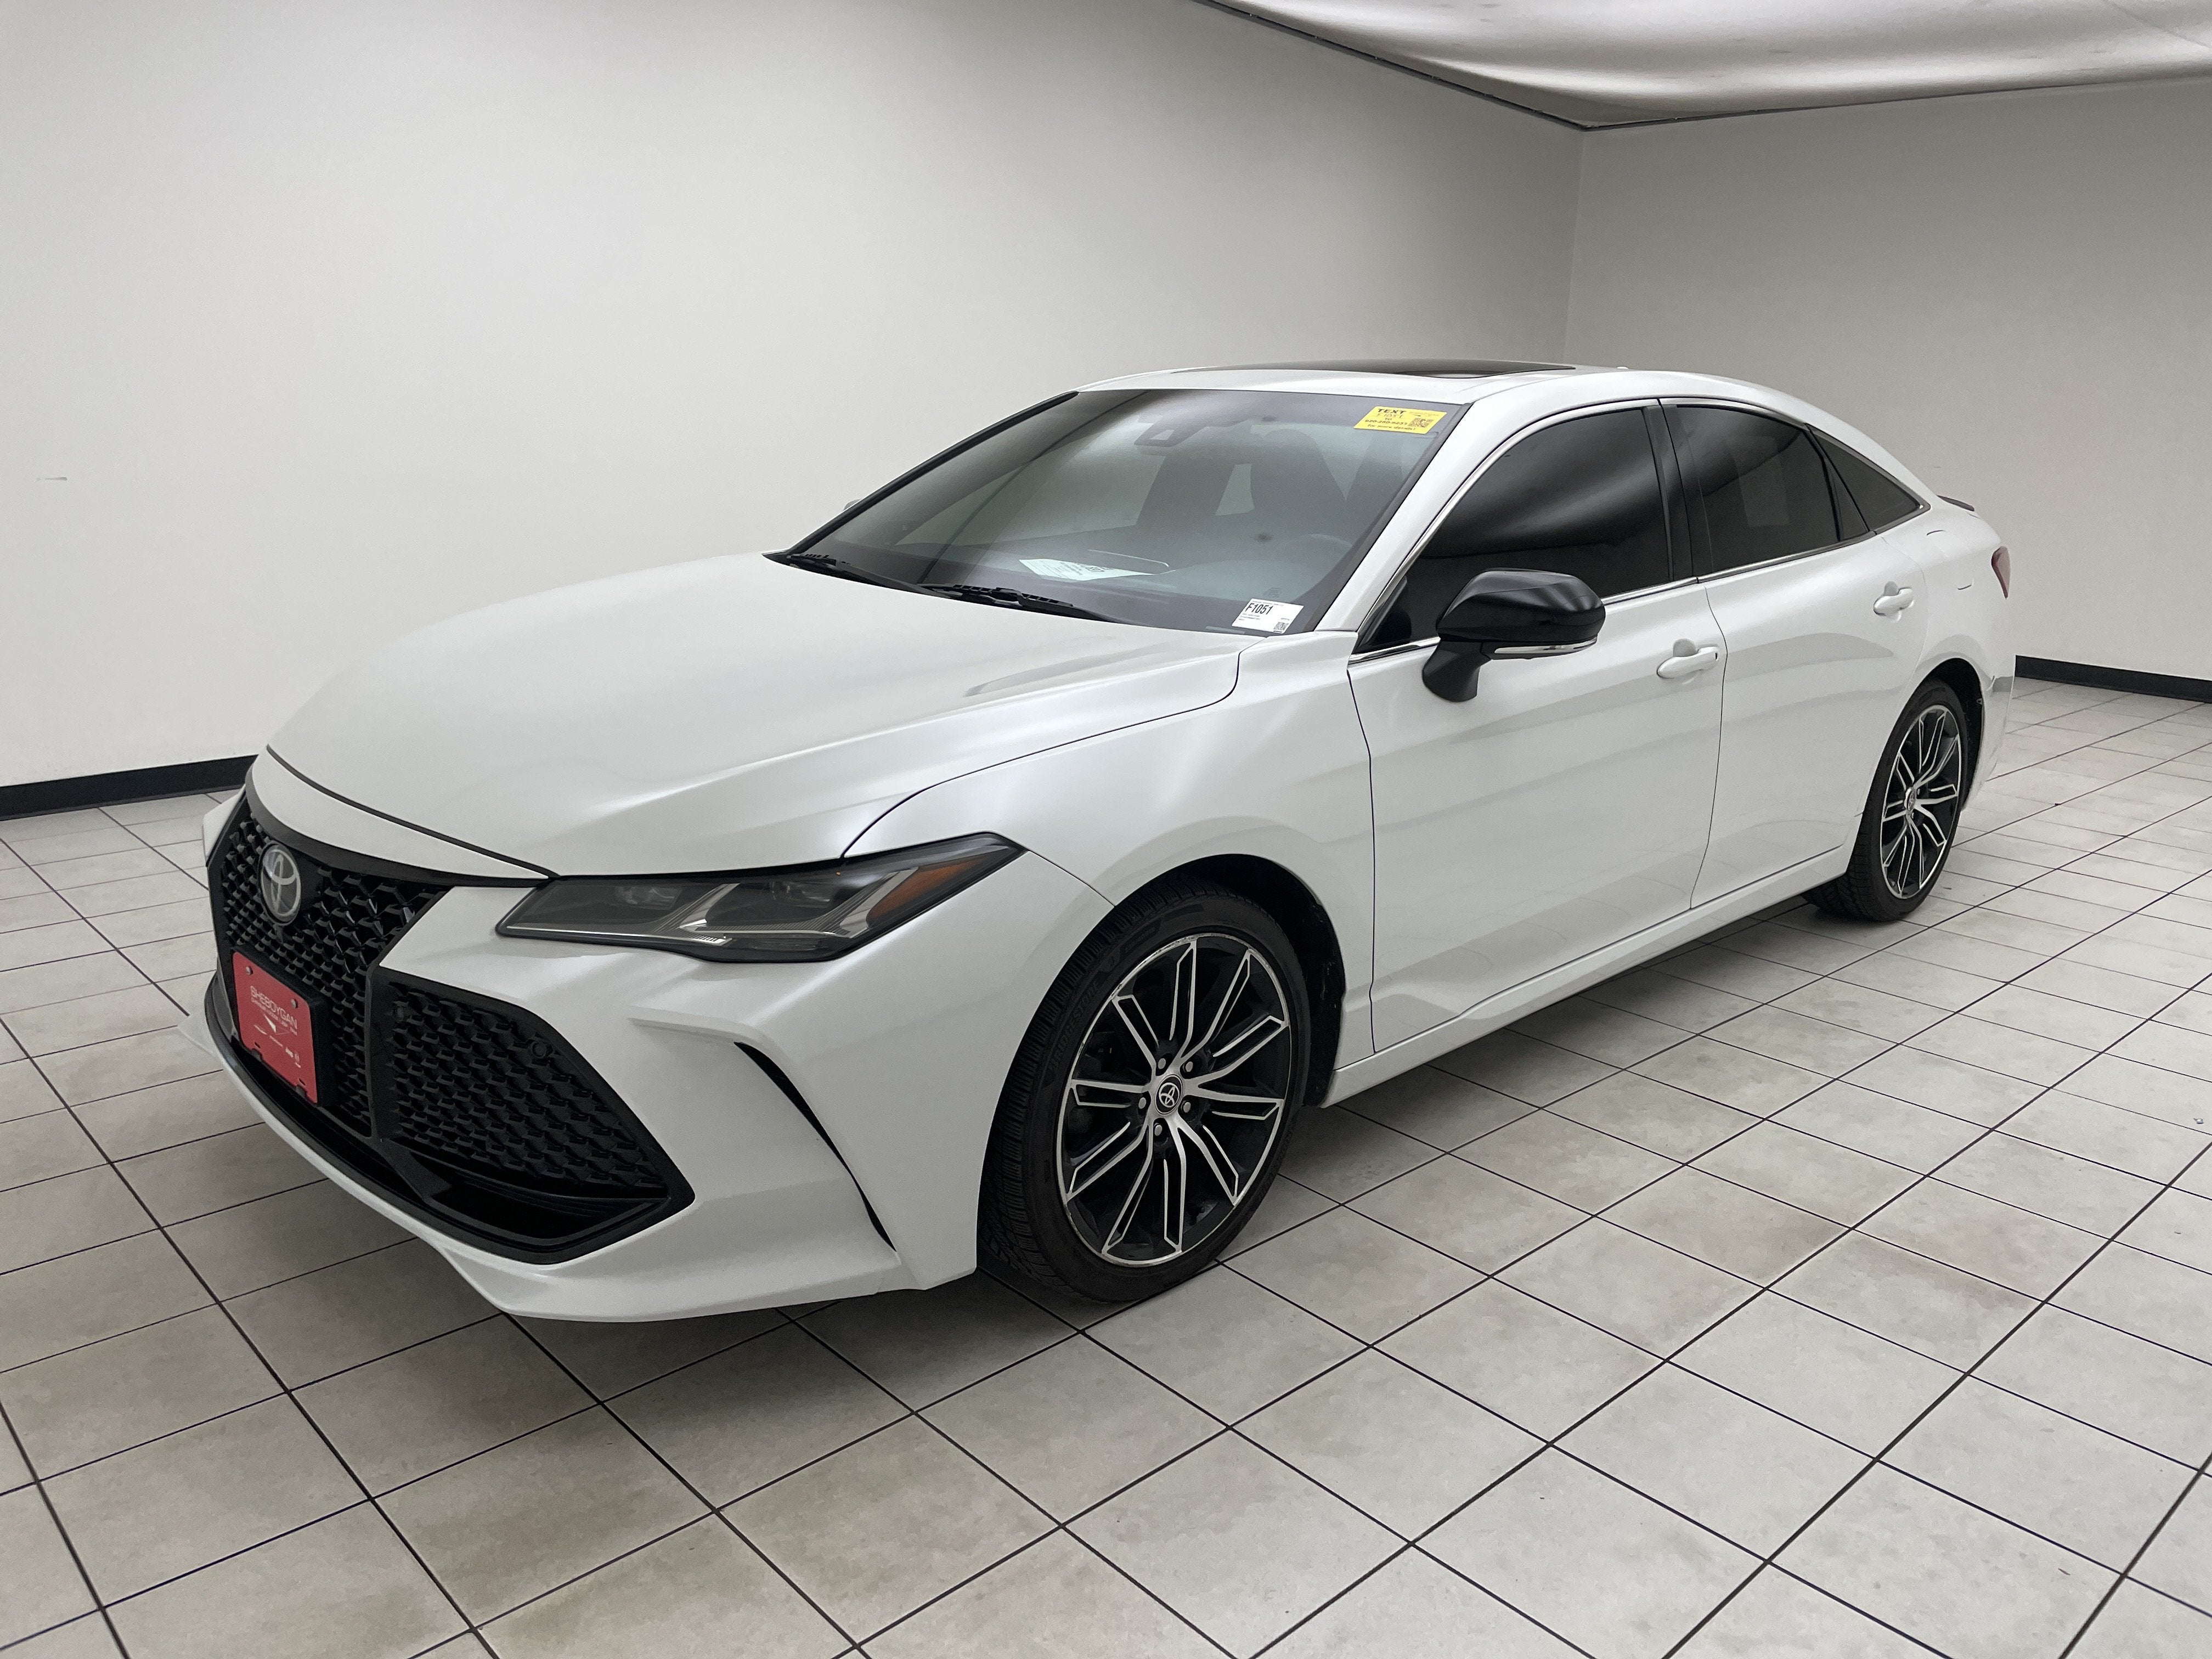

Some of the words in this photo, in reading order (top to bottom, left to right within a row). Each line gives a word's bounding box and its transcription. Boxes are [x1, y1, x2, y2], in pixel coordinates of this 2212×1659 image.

[1244, 602, 1274, 615] F1051
[250, 986, 297, 1030] SHEBOYGAN
[1047, 979, 1099, 1073] BRIDGESTONE
